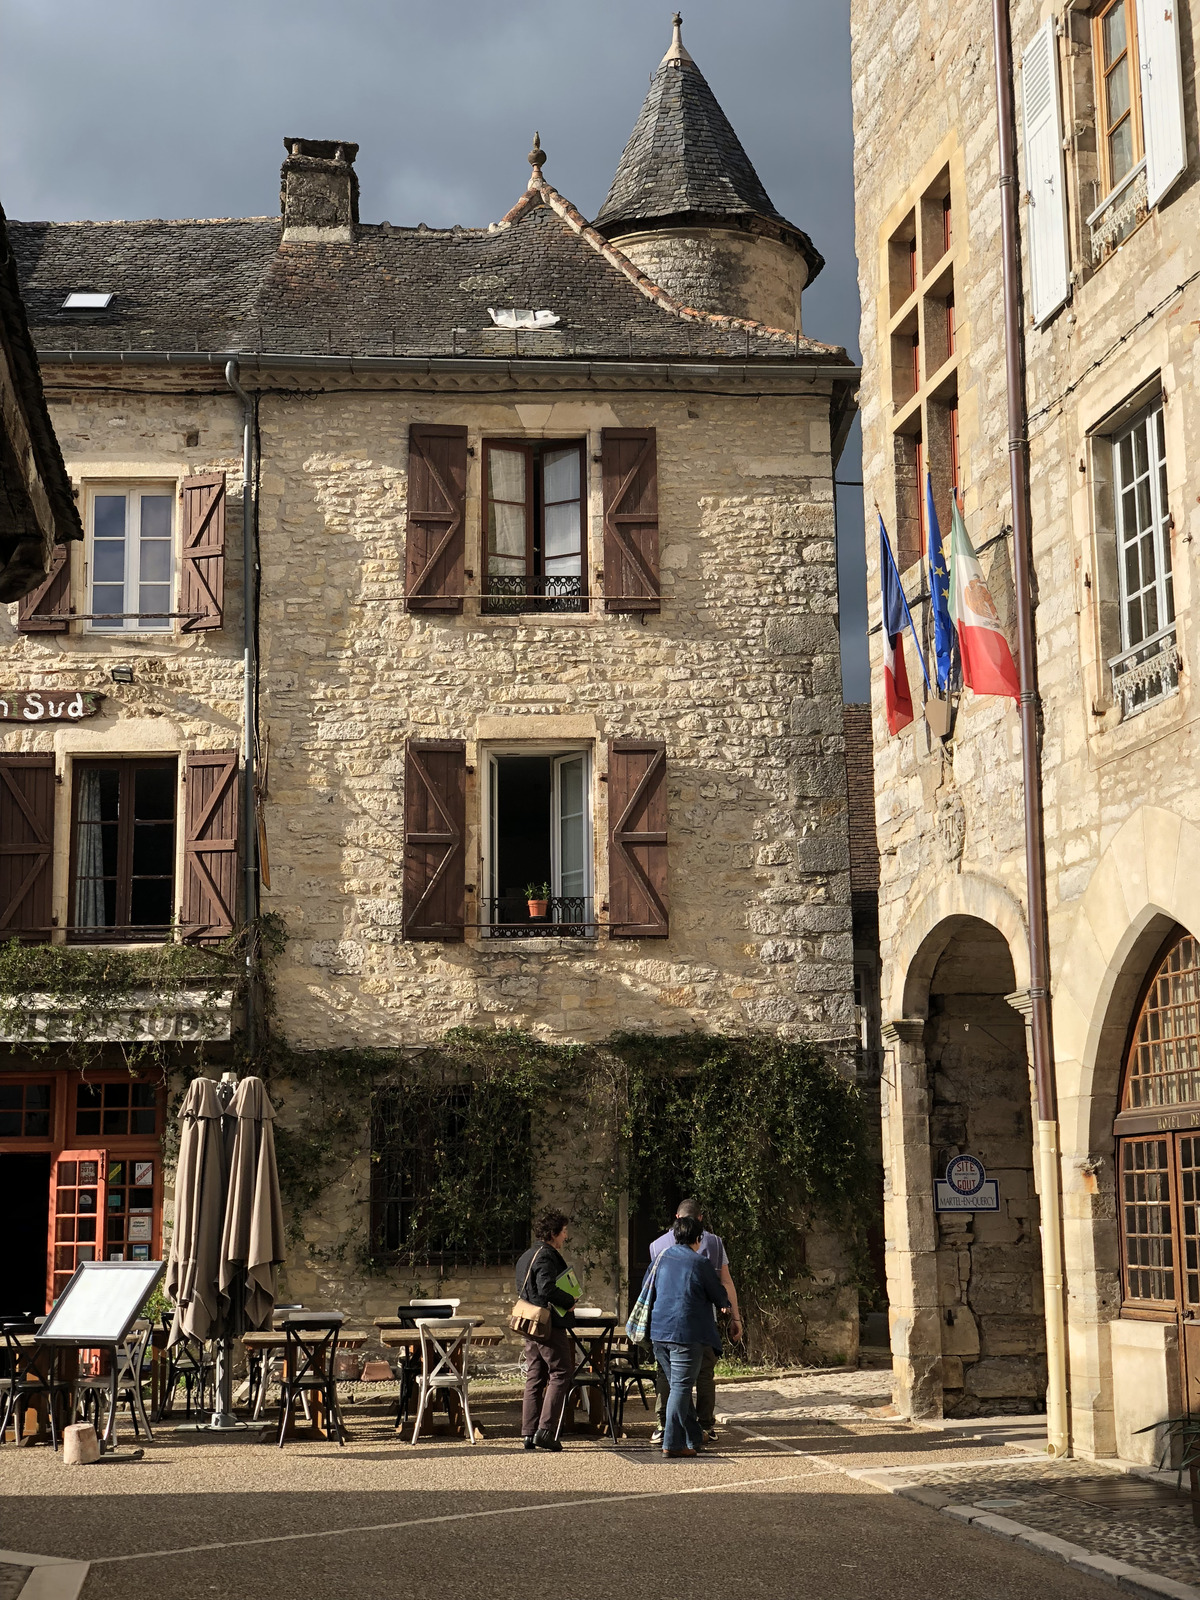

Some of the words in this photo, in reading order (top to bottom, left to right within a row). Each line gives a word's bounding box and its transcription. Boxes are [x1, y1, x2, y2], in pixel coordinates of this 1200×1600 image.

[22, 692, 84, 720] Sud
[1157, 1116, 1180, 1129] HOTEL
[956, 1161, 975, 1172] SITE
[957, 1179, 976, 1190] GOUT
[940, 1197, 994, 1207] MARTEL-EN-QUERCY
